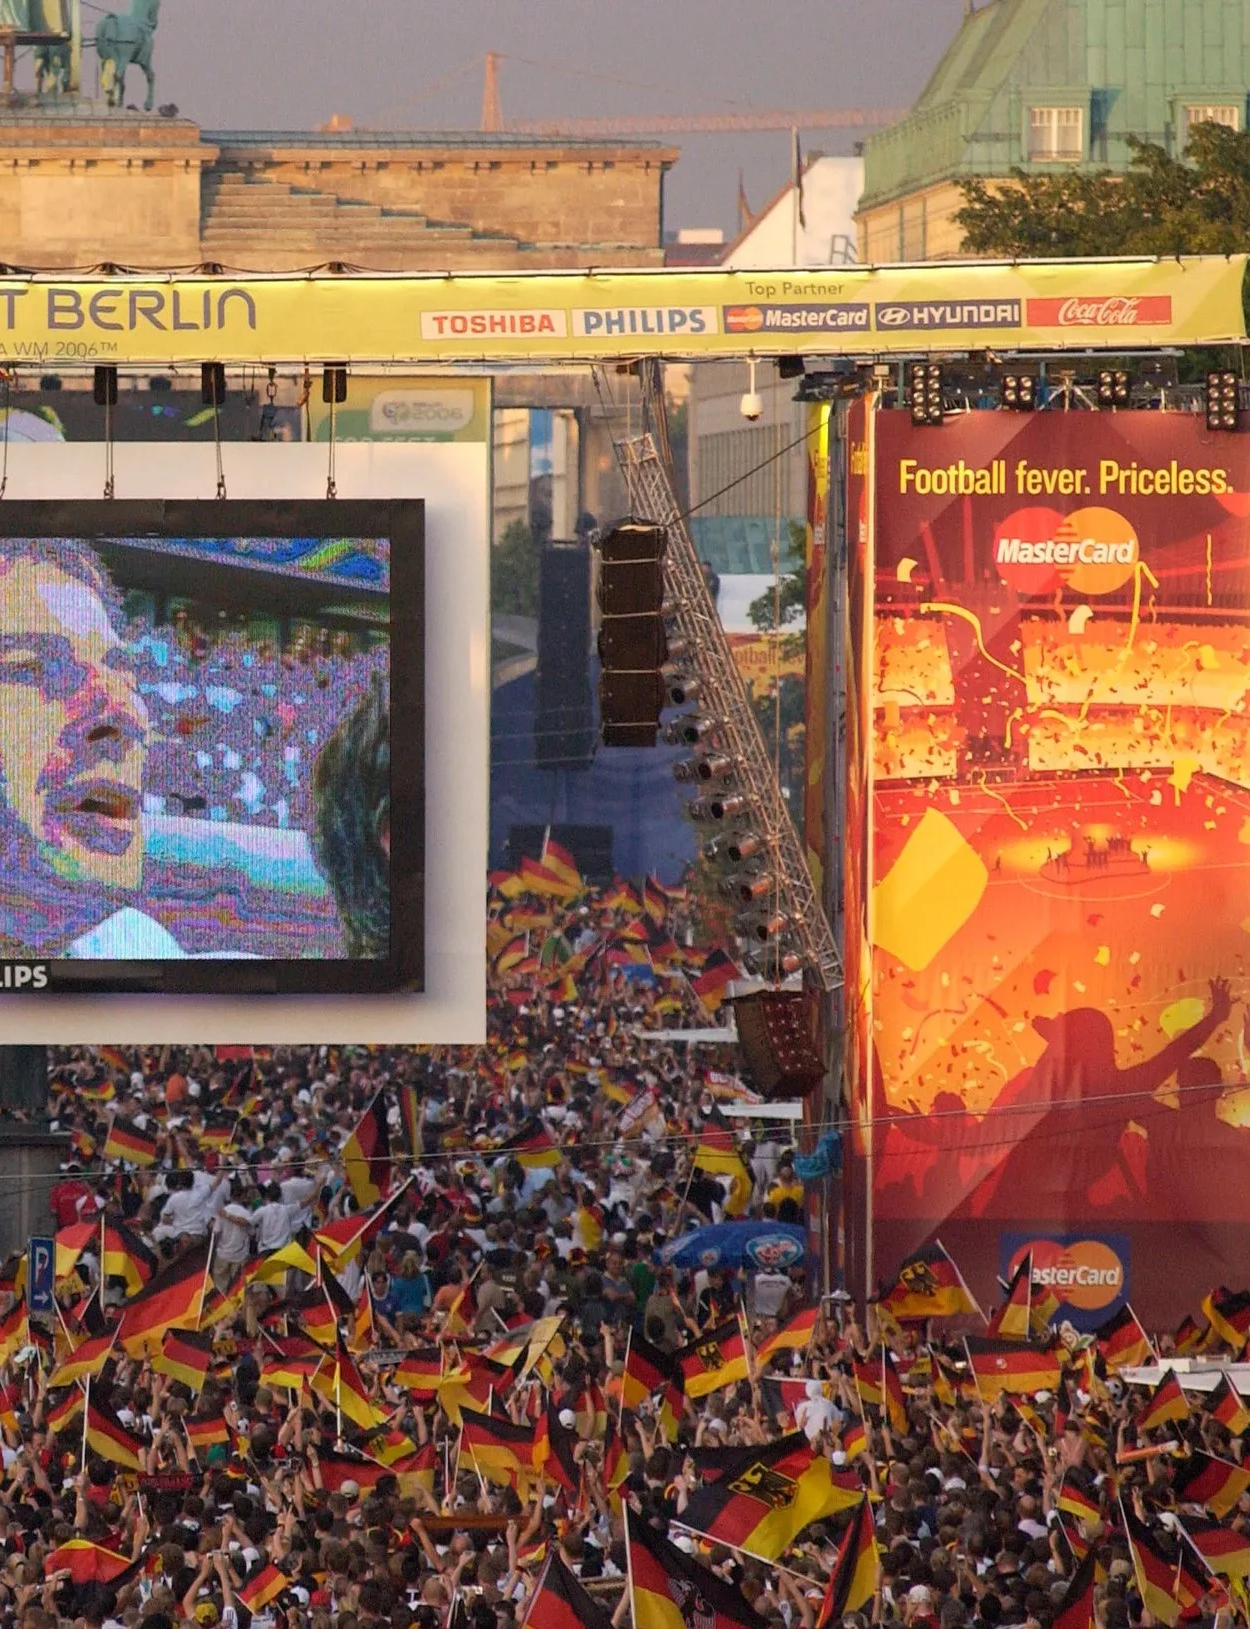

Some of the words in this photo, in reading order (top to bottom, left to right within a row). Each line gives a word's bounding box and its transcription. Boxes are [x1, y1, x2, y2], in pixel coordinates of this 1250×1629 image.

[744, 281, 776, 299] Top
[782, 281, 845, 297] Partner
[47, 289, 257, 331] BERLIN
[584, 308, 706, 335] PHILIPS
[765, 308, 868, 328] MasterCard
[913, 304, 1020, 324] HYUNDAI
[1058, 297, 1138, 326] Coca-Cola
[432, 314, 555, 334] TOSHIBA
[13, 341, 49, 357] WM
[899, 459, 1006, 495] Football
[1015, 460, 1091, 495] fever.
[1099, 460, 1234, 496] Priceless.
[996, 537, 1136, 565] MasterCard
[35, 1246, 49, 1283] P
